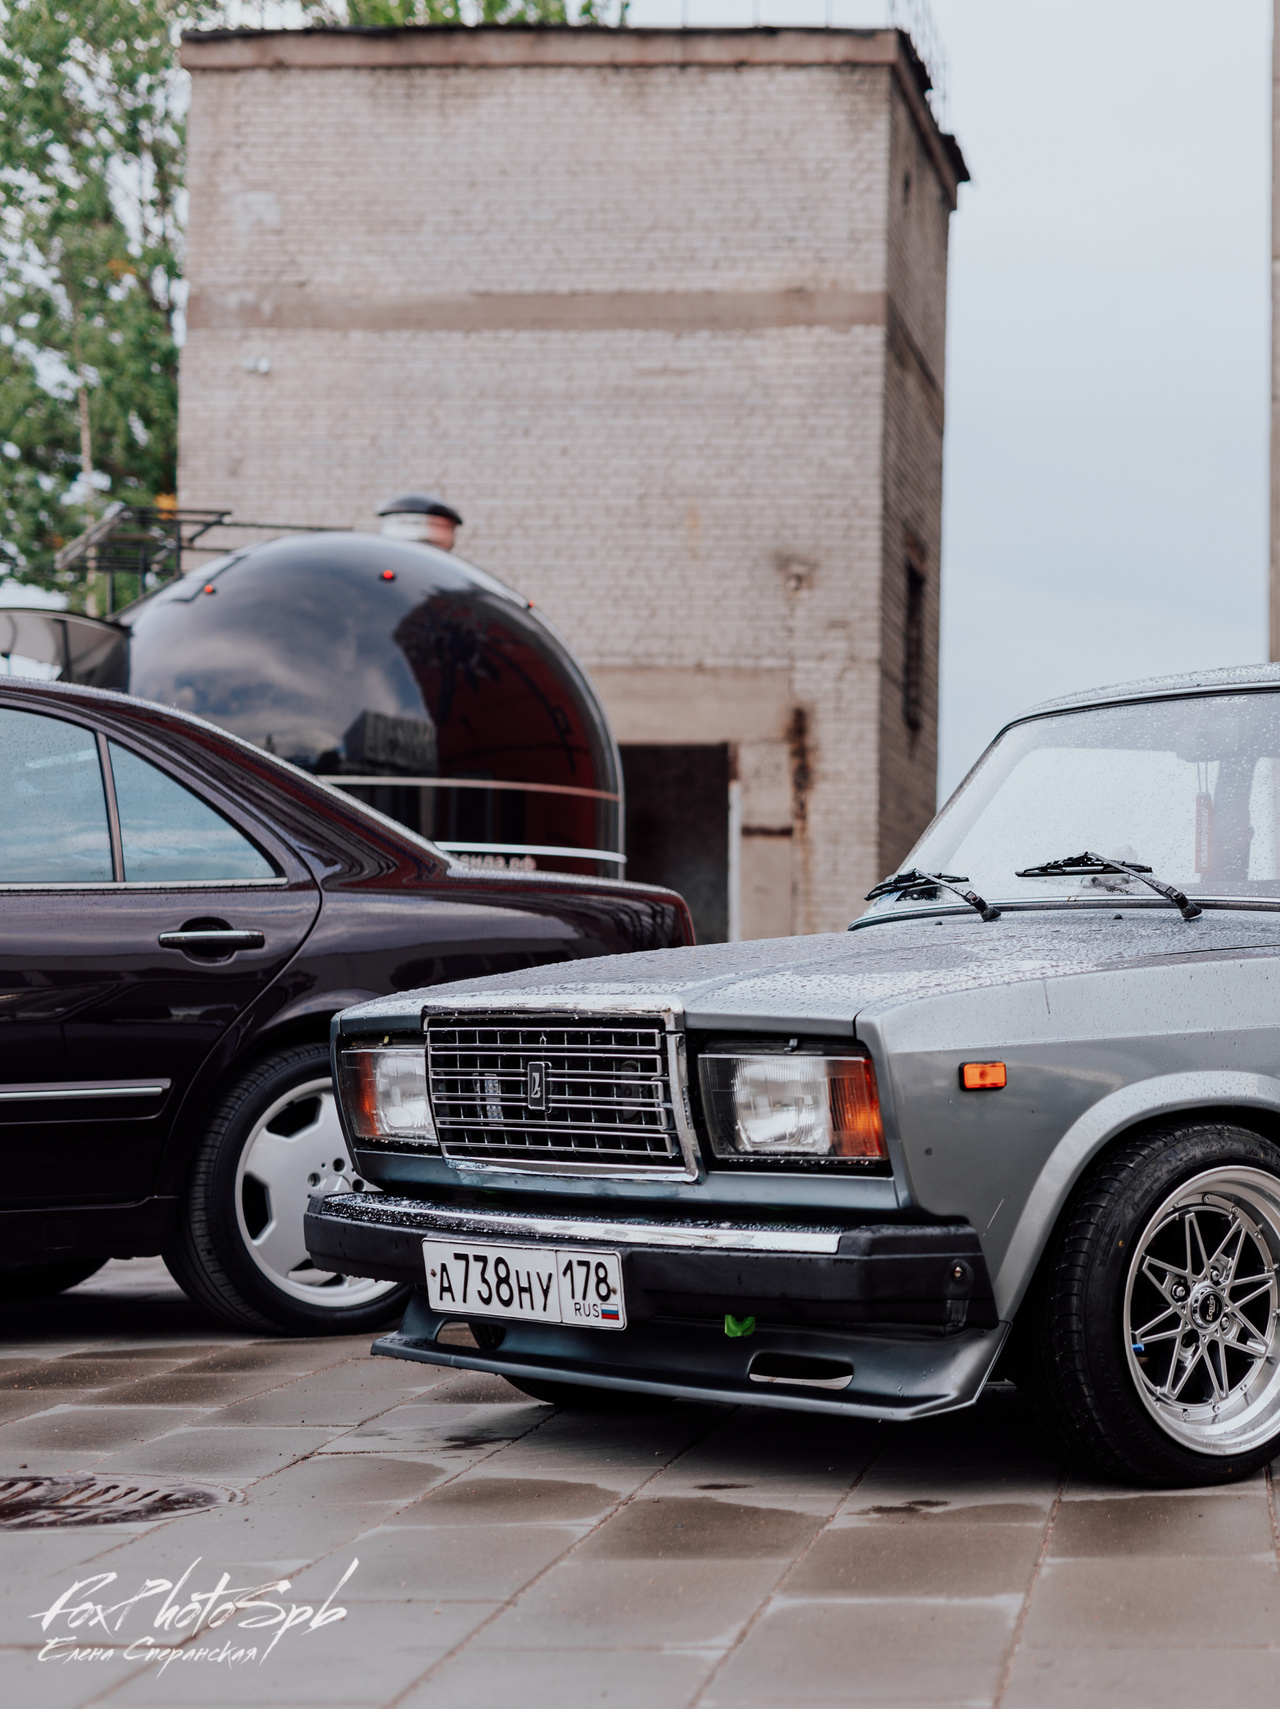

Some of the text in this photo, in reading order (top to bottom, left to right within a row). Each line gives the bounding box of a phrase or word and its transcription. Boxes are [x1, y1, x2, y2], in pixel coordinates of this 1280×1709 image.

[439, 1252, 611, 1312] А738НУ 178
[574, 1303, 600, 1318] RUS
